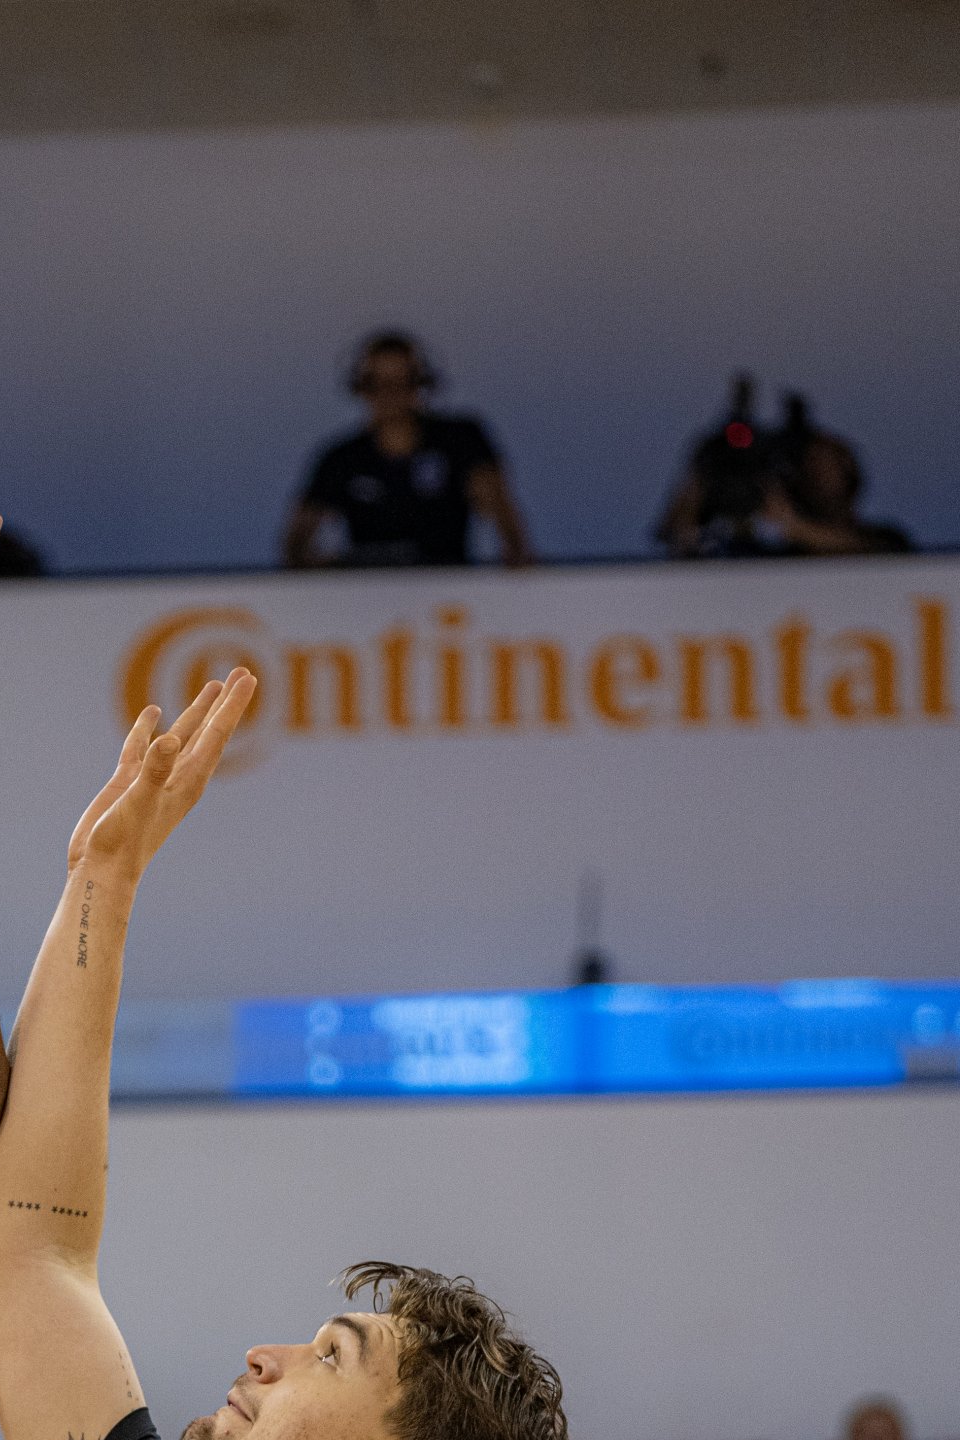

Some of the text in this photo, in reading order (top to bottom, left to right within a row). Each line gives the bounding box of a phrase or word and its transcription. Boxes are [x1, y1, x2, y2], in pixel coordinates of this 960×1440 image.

[118, 597, 958, 775] Continental
[76, 881, 94, 969] GO ONE MORE
